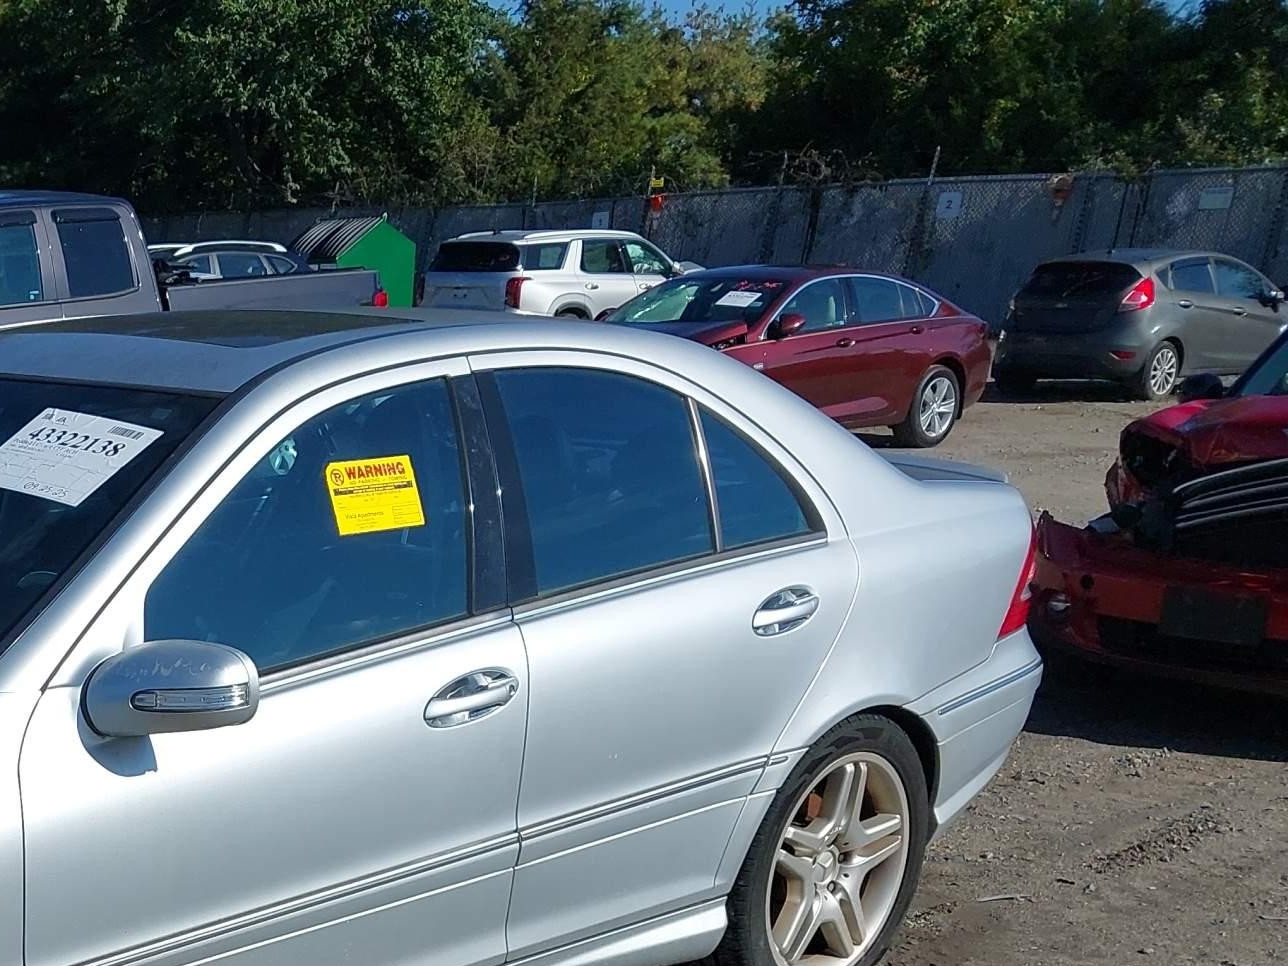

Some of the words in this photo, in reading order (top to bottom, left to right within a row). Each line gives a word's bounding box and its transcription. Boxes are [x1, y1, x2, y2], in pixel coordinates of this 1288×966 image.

[944, 199, 953, 209] 2
[28, 426, 127, 458] 43322138
[344, 461, 406, 481] WARNING
